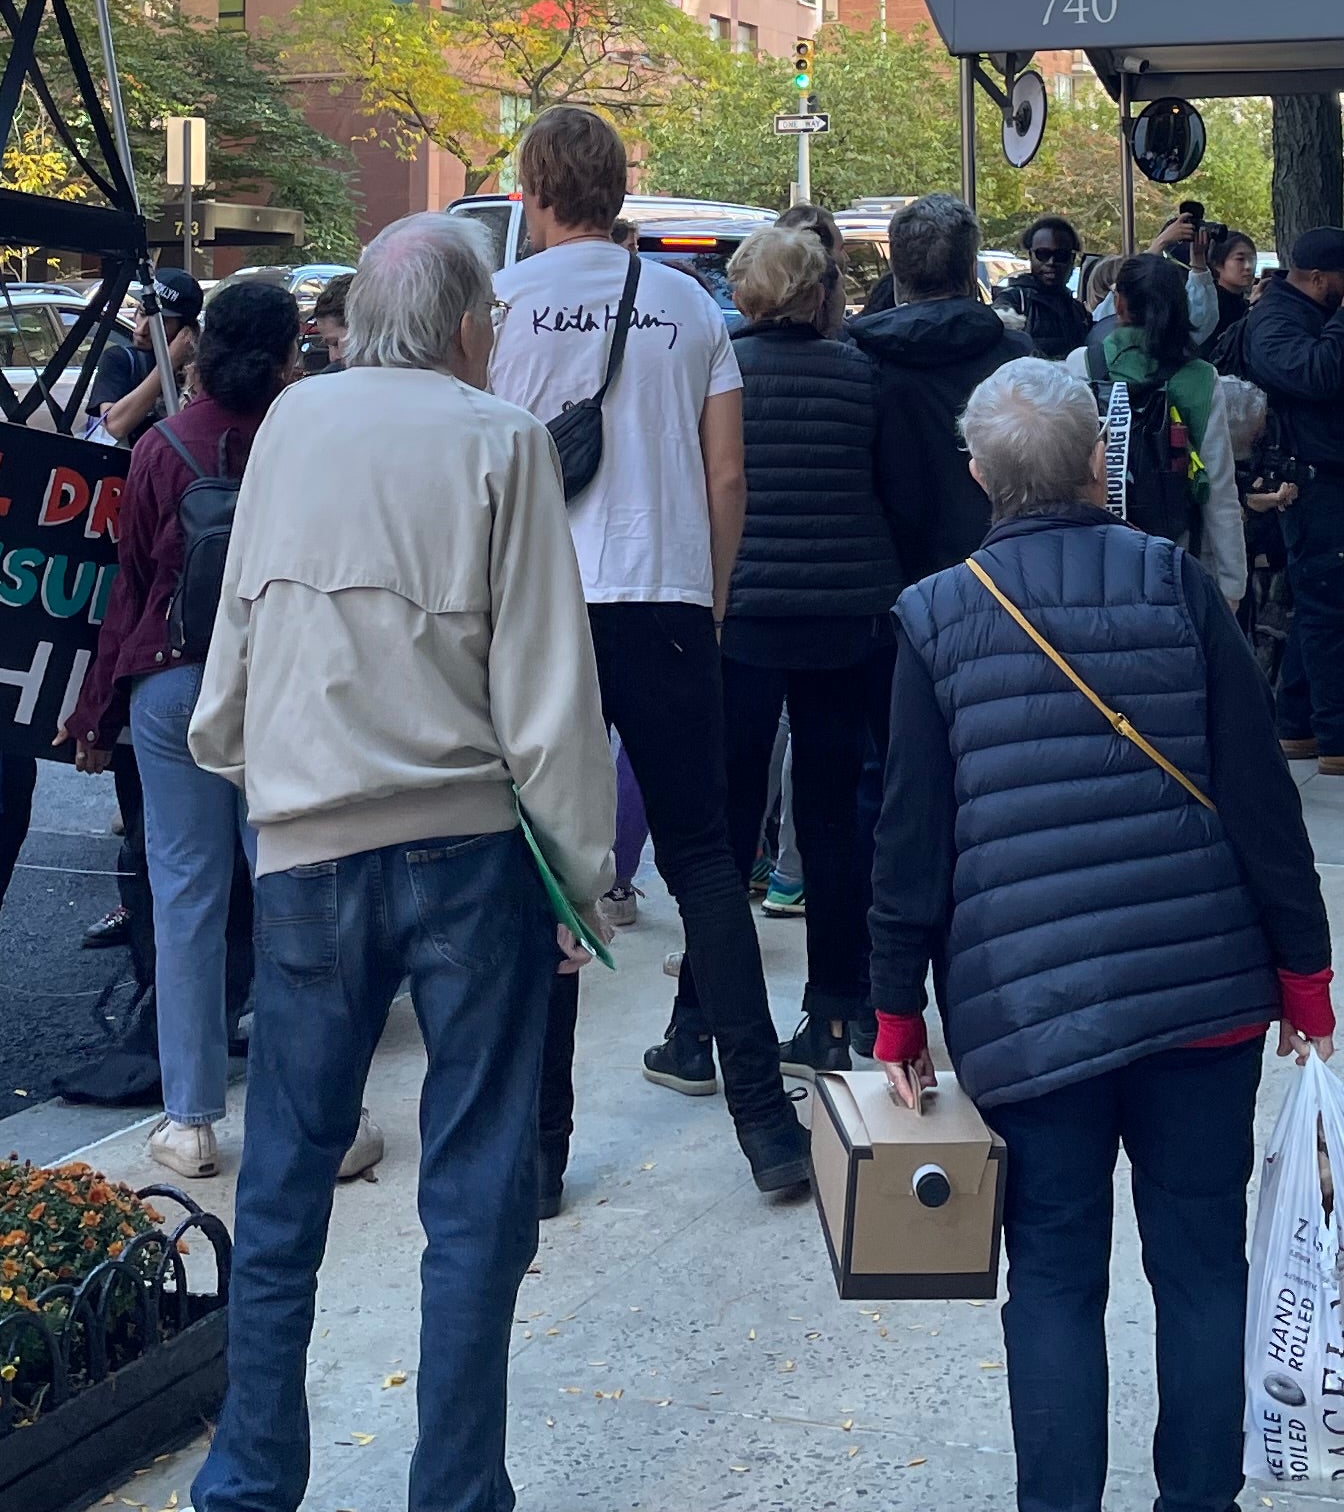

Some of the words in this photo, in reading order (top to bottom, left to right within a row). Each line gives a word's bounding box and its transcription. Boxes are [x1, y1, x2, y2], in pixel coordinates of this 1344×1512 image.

[782, 121, 797, 129] ONE
[805, 120, 820, 128] WAY
[174, 221, 199, 236] 73
[532, 304, 600, 335] Keith
[1268, 1287, 1296, 1363] HAND
[1288, 1297, 1315, 1372] ROLLED
[1263, 1409, 1283, 1482] KETTLE
[1288, 1418, 1310, 1482] BOILED
